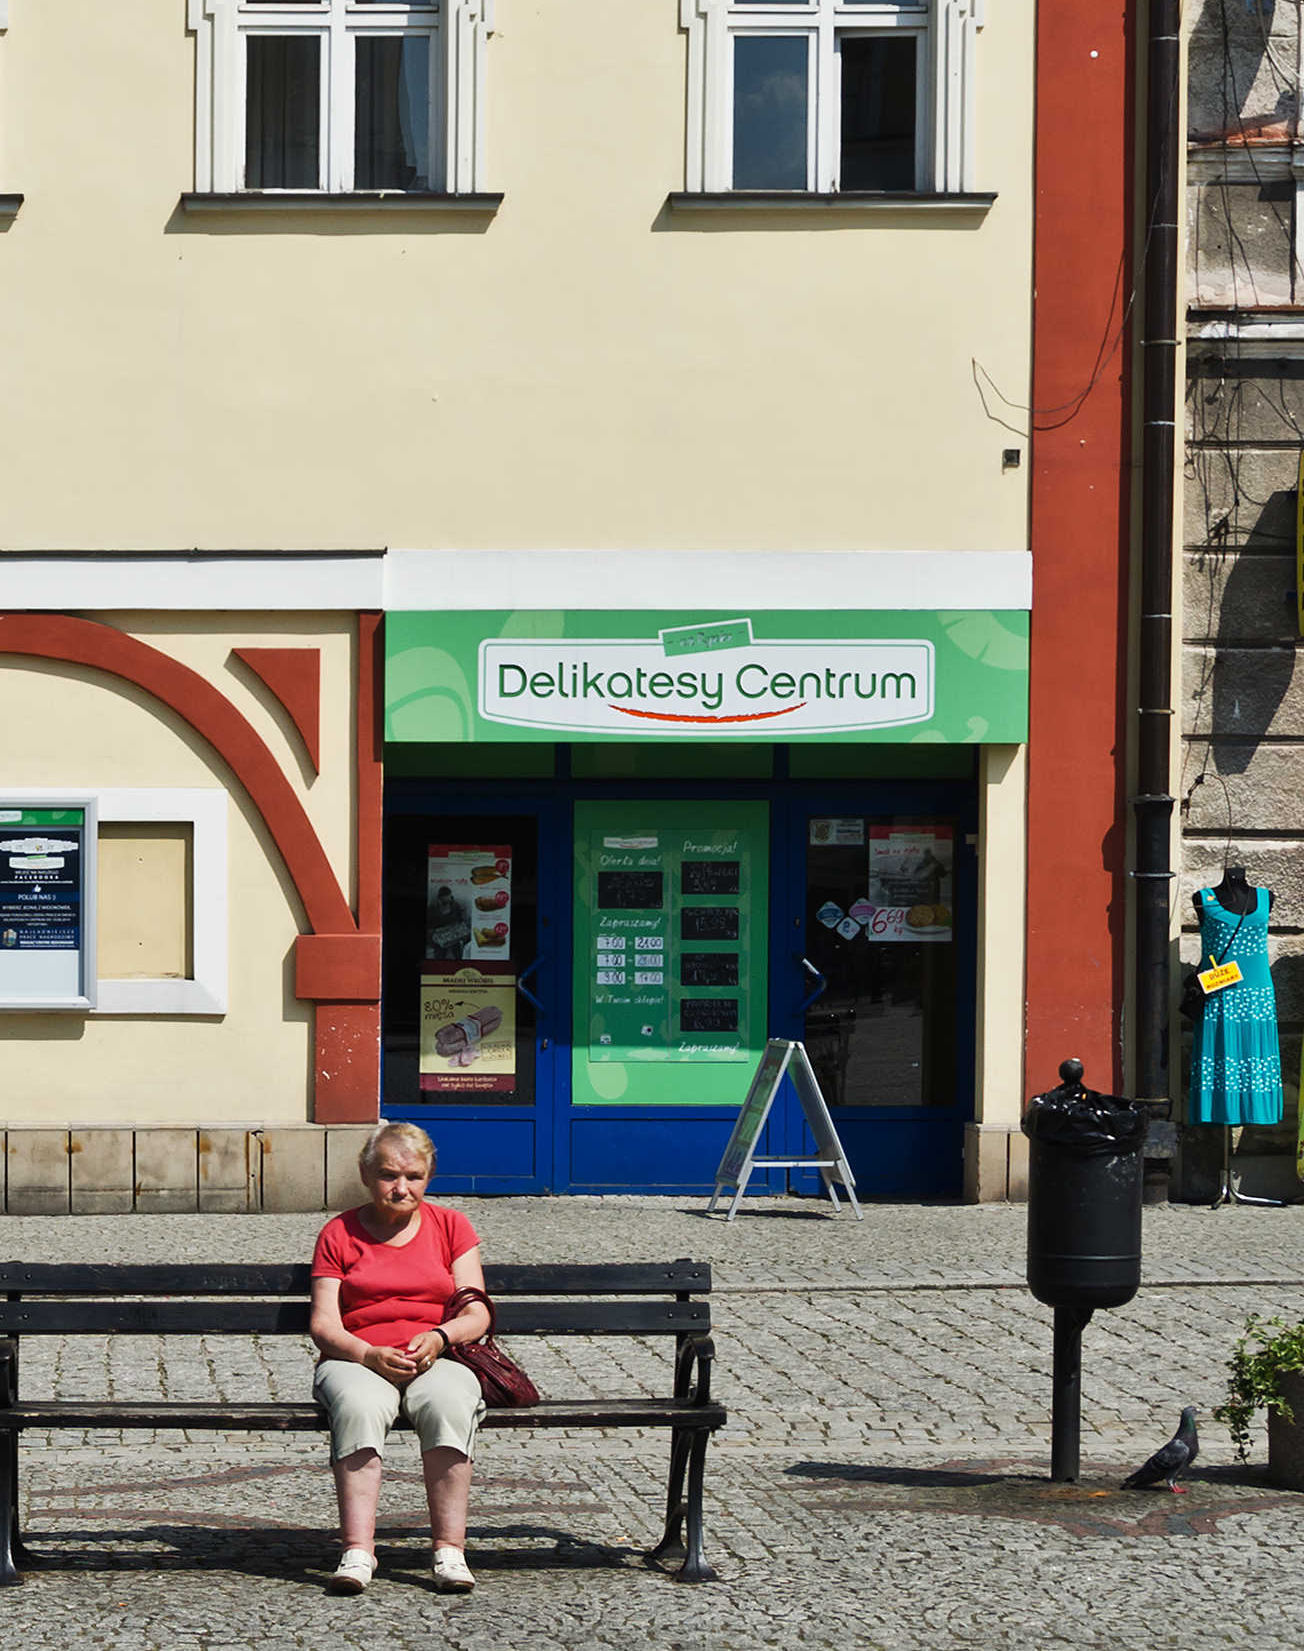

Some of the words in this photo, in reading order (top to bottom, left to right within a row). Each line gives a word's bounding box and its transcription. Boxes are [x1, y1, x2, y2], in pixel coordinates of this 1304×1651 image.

[498, 662, 724, 710] Delikatesy
[736, 663, 917, 699] Centrum
[683, 841, 737, 855] Promocja!
[600, 855, 634, 866] Oferta
[599, 916, 661, 929] Zapraszamy!
[1207, 974, 1238, 989] ROZMIARY
[424, 999, 454, 1012] 80%
[424, 1012, 454, 1021] mięsa
[678, 1041, 740, 1055] Zapraszamy!
